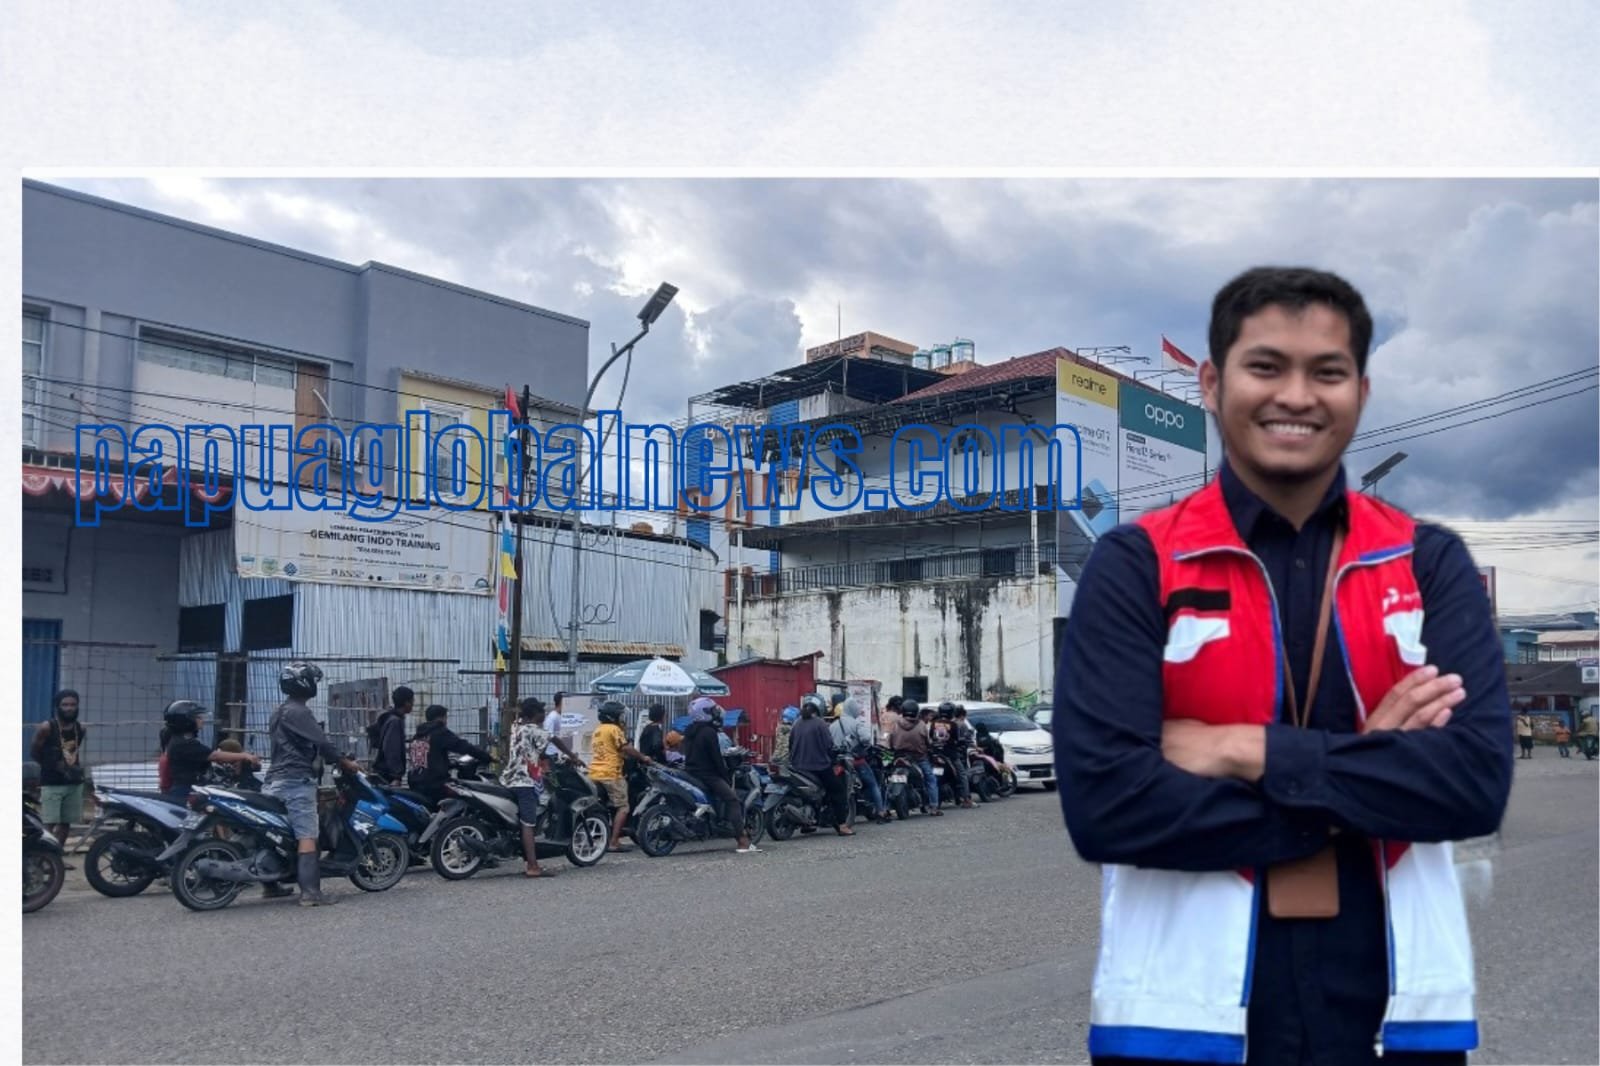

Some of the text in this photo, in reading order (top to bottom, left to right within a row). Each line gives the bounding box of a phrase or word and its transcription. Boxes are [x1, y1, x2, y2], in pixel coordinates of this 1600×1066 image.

[1071, 373, 1107, 396] realme
[1144, 402, 1185, 430] oppo
[310, 529, 365, 544] GEMILANG
[367, 535, 394, 547] INDO
[396, 538, 441, 551] TRAINING
